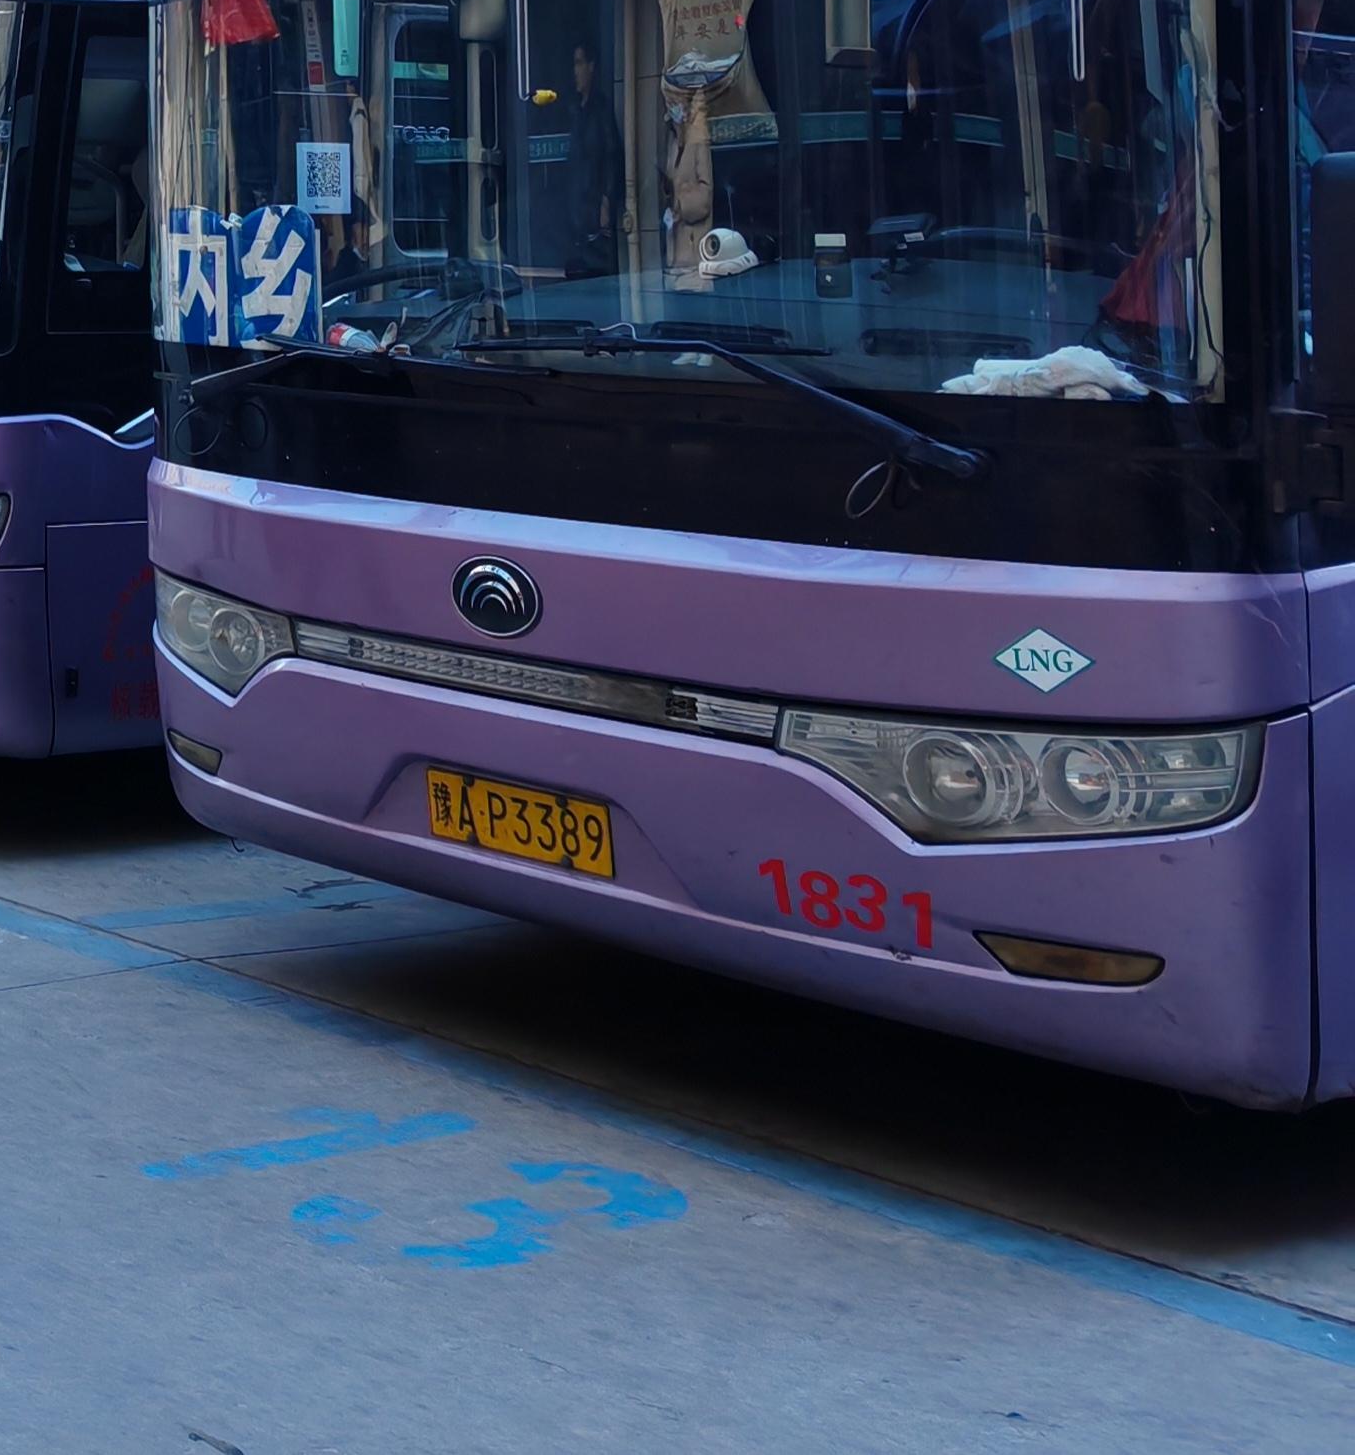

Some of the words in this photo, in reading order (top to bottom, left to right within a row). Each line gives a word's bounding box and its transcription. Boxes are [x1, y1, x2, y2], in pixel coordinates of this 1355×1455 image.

[169, 206, 312, 352] 内乡
[1012, 648, 1073, 673] LNG
[759, 859, 933, 950] 1831
